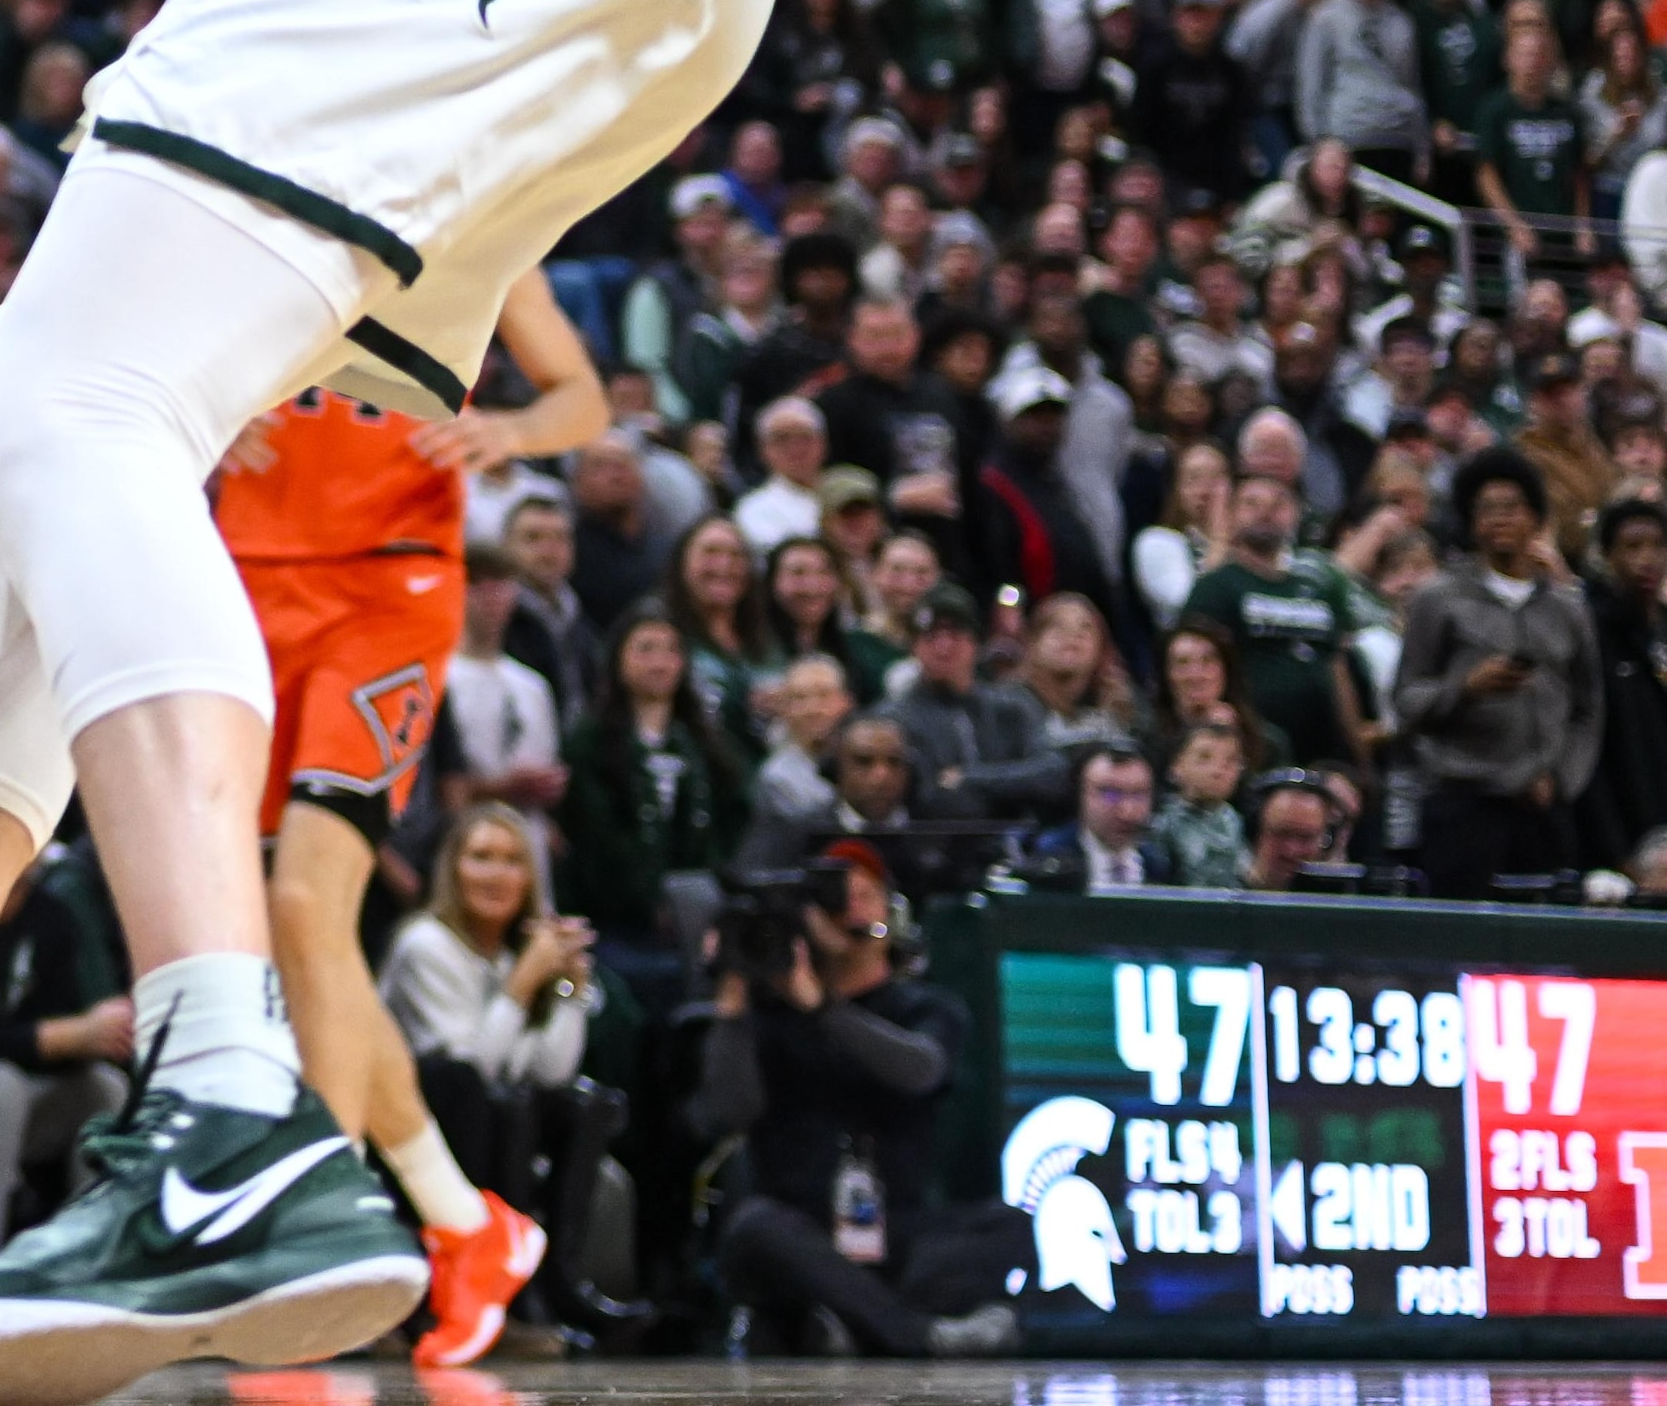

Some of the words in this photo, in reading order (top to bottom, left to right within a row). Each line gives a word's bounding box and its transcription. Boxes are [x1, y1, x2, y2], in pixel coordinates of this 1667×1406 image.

[1113, 962, 1252, 1107] 47
[1269, 985, 1465, 1089] 13:38
[1471, 978, 1597, 1117] 47
[1311, 1161, 1431, 1252] 2ND
[1268, 1263, 1355, 1316] POSS
[1395, 1265, 1482, 1317] POSS
